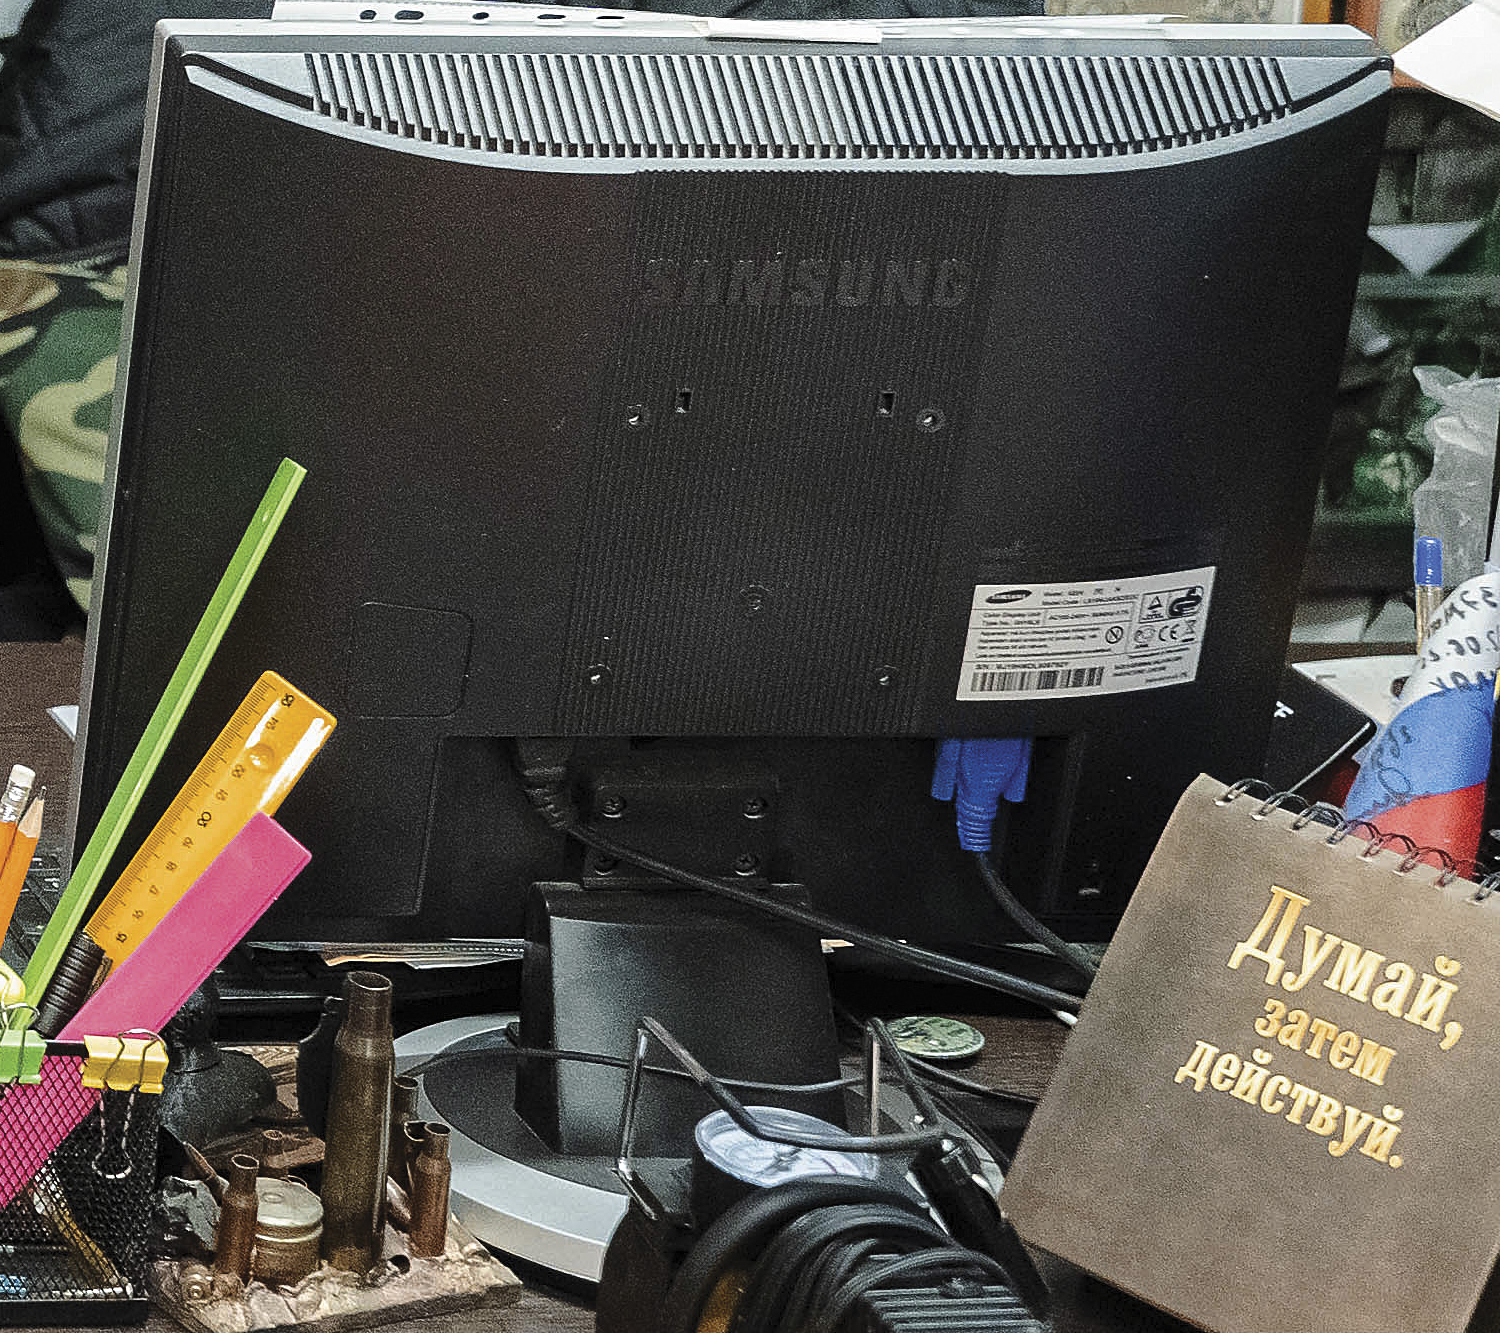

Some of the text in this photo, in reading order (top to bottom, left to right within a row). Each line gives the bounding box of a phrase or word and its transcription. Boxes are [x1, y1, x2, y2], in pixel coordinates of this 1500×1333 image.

[644, 257, 974, 309] SAMSUNG
[282, 691, 295, 708] 25
[197, 811, 212, 828] 20
[182, 836, 194, 850] 19
[165, 860, 178, 874] 18
[149, 884, 160, 896] 17
[131, 909, 145, 921] 16
[115, 932, 128, 944] 15
[1227, 884, 1464, 1052] Думай,
[1254, 997, 1398, 1088] затем
[1173, 1040, 1405, 1169] действуй.
